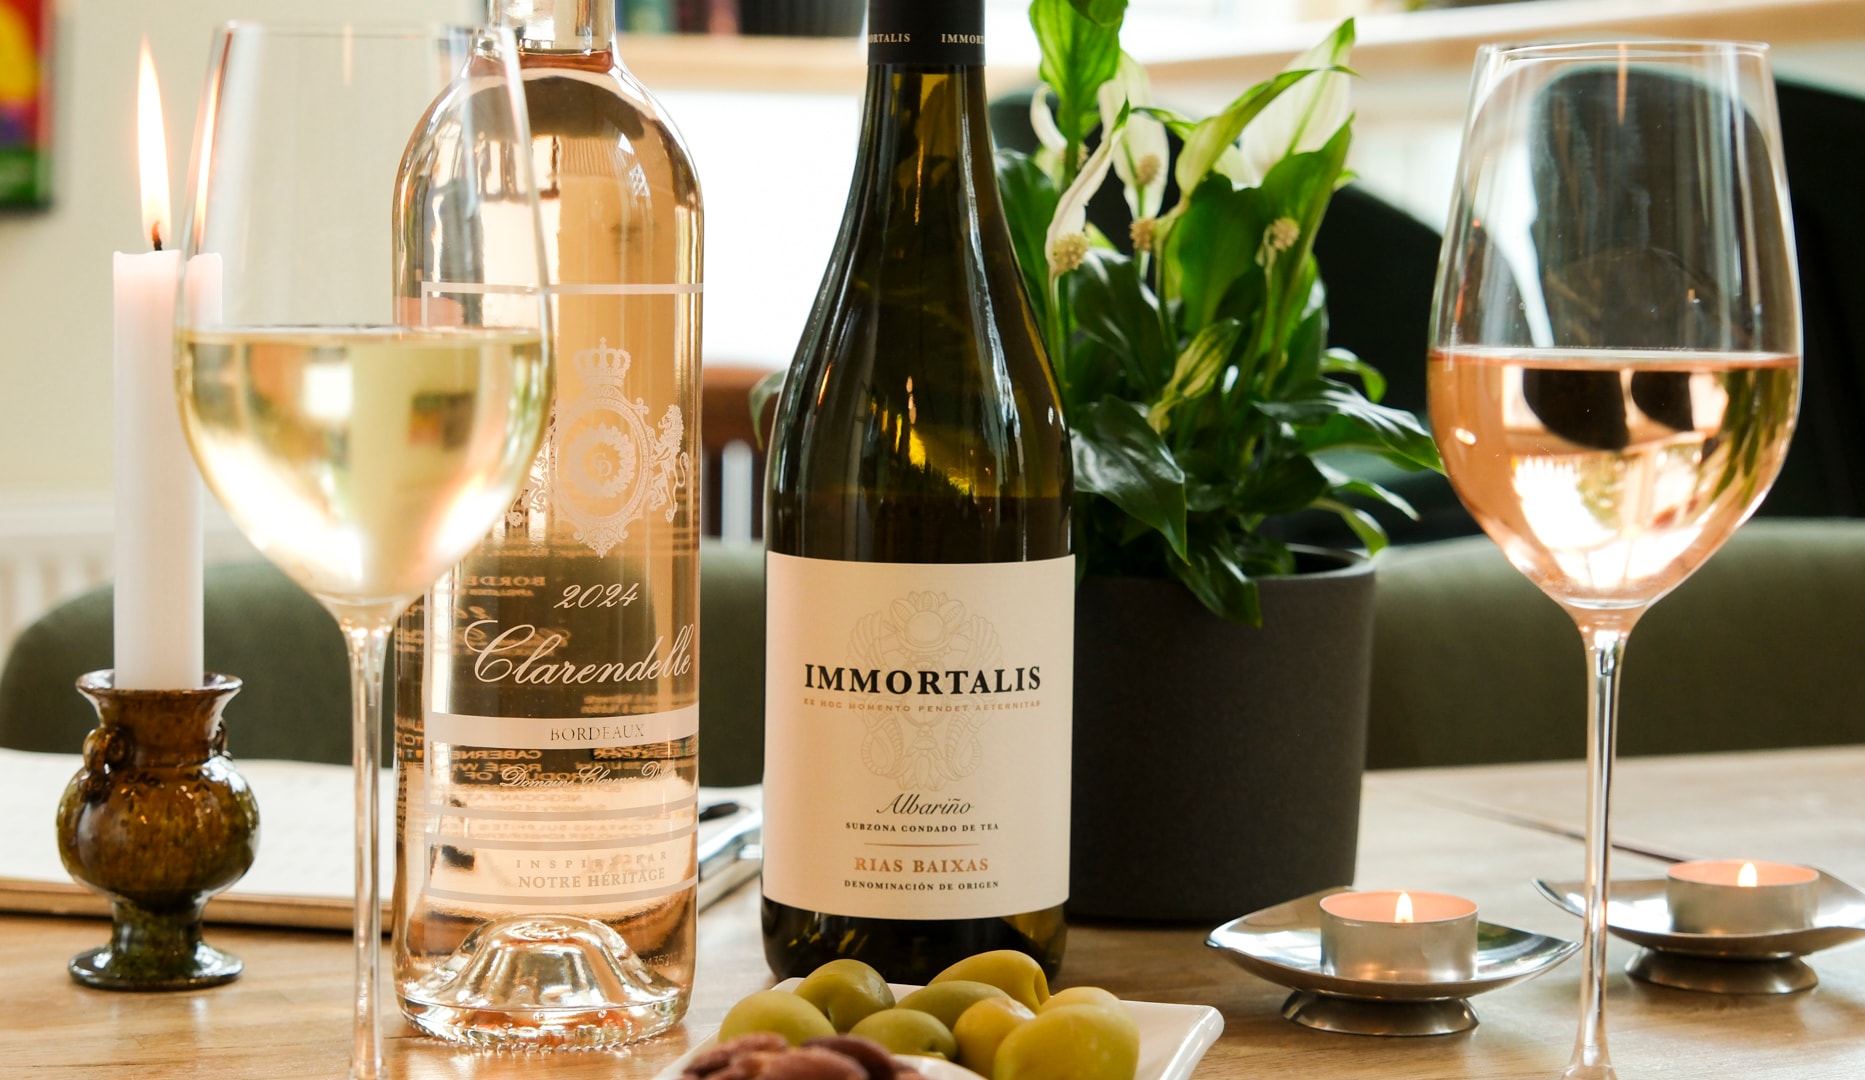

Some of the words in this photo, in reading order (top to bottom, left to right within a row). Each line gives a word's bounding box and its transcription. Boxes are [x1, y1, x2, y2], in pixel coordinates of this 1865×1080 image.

[553, 582, 640, 609] 2024
[464, 619, 694, 685] Clarendelle
[803, 663, 1042, 695] IMMORTALIS
[848, 702, 911, 712] MOMENTO
[918, 703, 969, 713] PENDET
[549, 723, 645, 742] BORDEAUX
[499, 766, 575, 788] Domaine
[875, 792, 976, 816] Albariño
[845, 821, 898, 833] SUBZONA
[901, 822, 957, 833] CONDADO
[961, 822, 976, 832] DE
[980, 821, 1000, 832] TEA
[853, 856, 904, 873] RIAS
[913, 856, 989, 873] BAIXAS
[518, 874, 582, 889] NOTRE
[587, 867, 666, 888] HÉRITAGE
[844, 878, 935, 891] DENOMINACIÓN
[939, 880, 954, 891] DE
[958, 879, 999, 891] ORIGEN
